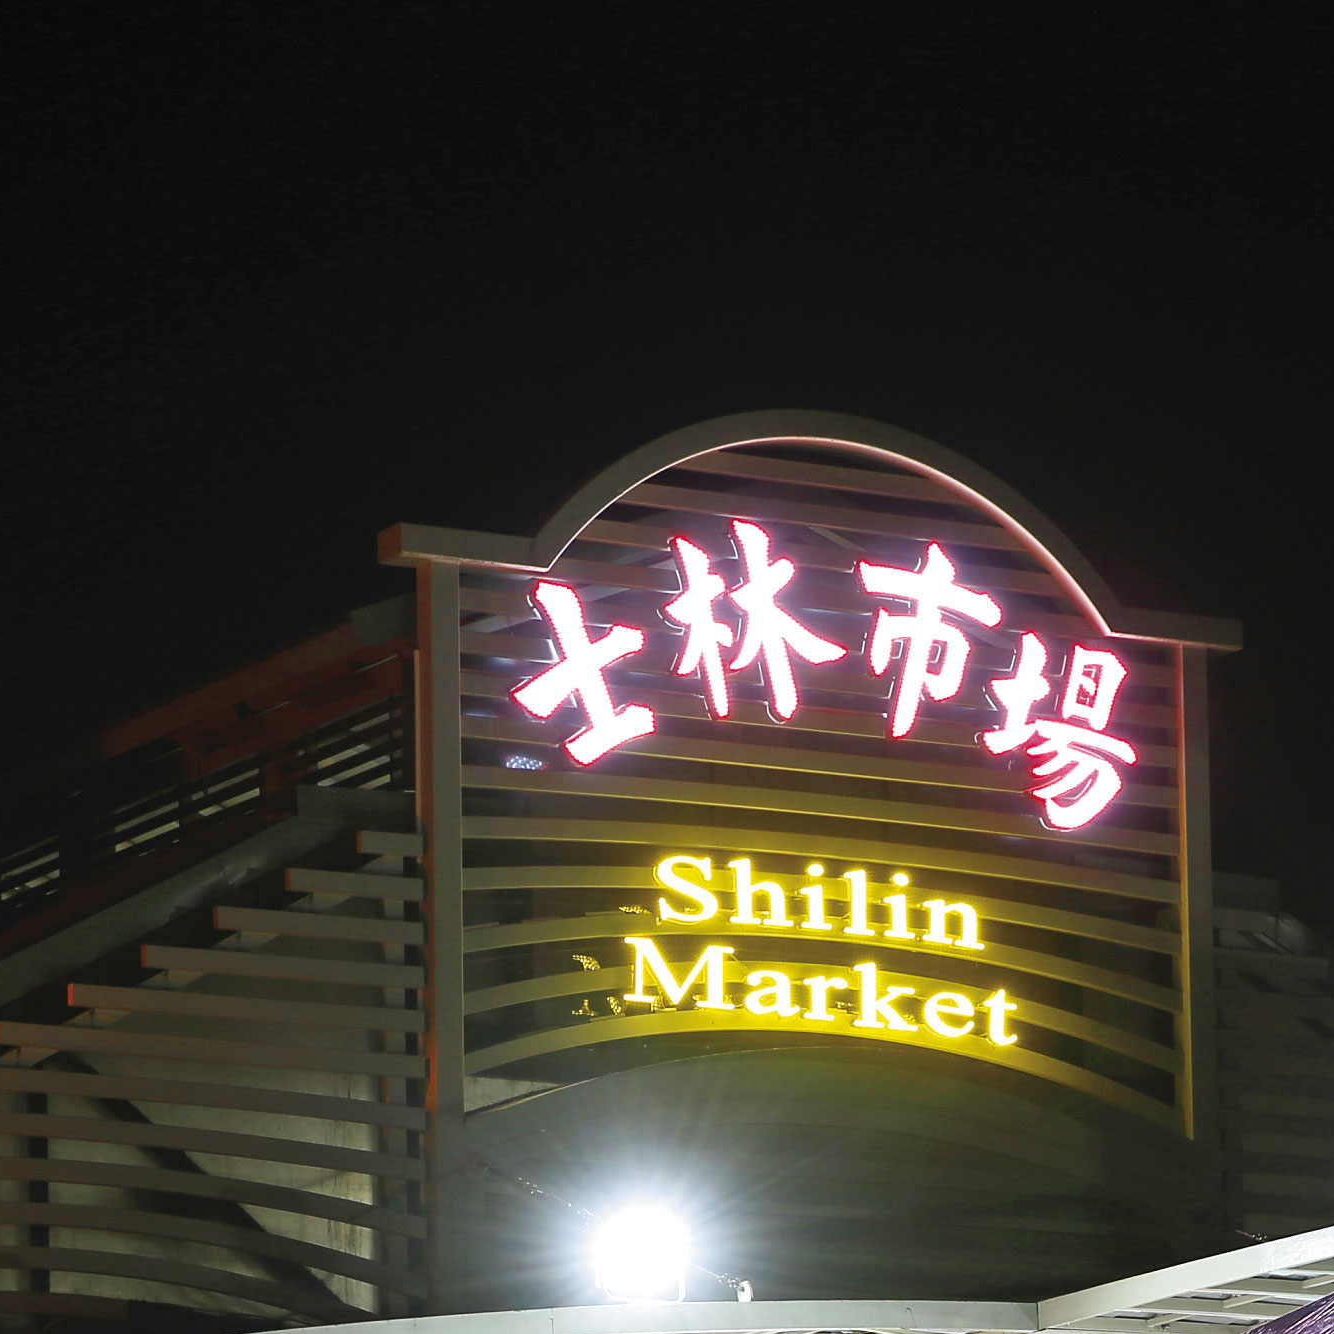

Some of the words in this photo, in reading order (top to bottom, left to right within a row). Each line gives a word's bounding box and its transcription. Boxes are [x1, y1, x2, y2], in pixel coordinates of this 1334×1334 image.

[511, 518, 1137, 831] 士林市場
[655, 854, 986, 951] Shilin
[622, 935, 1019, 1047] Market
